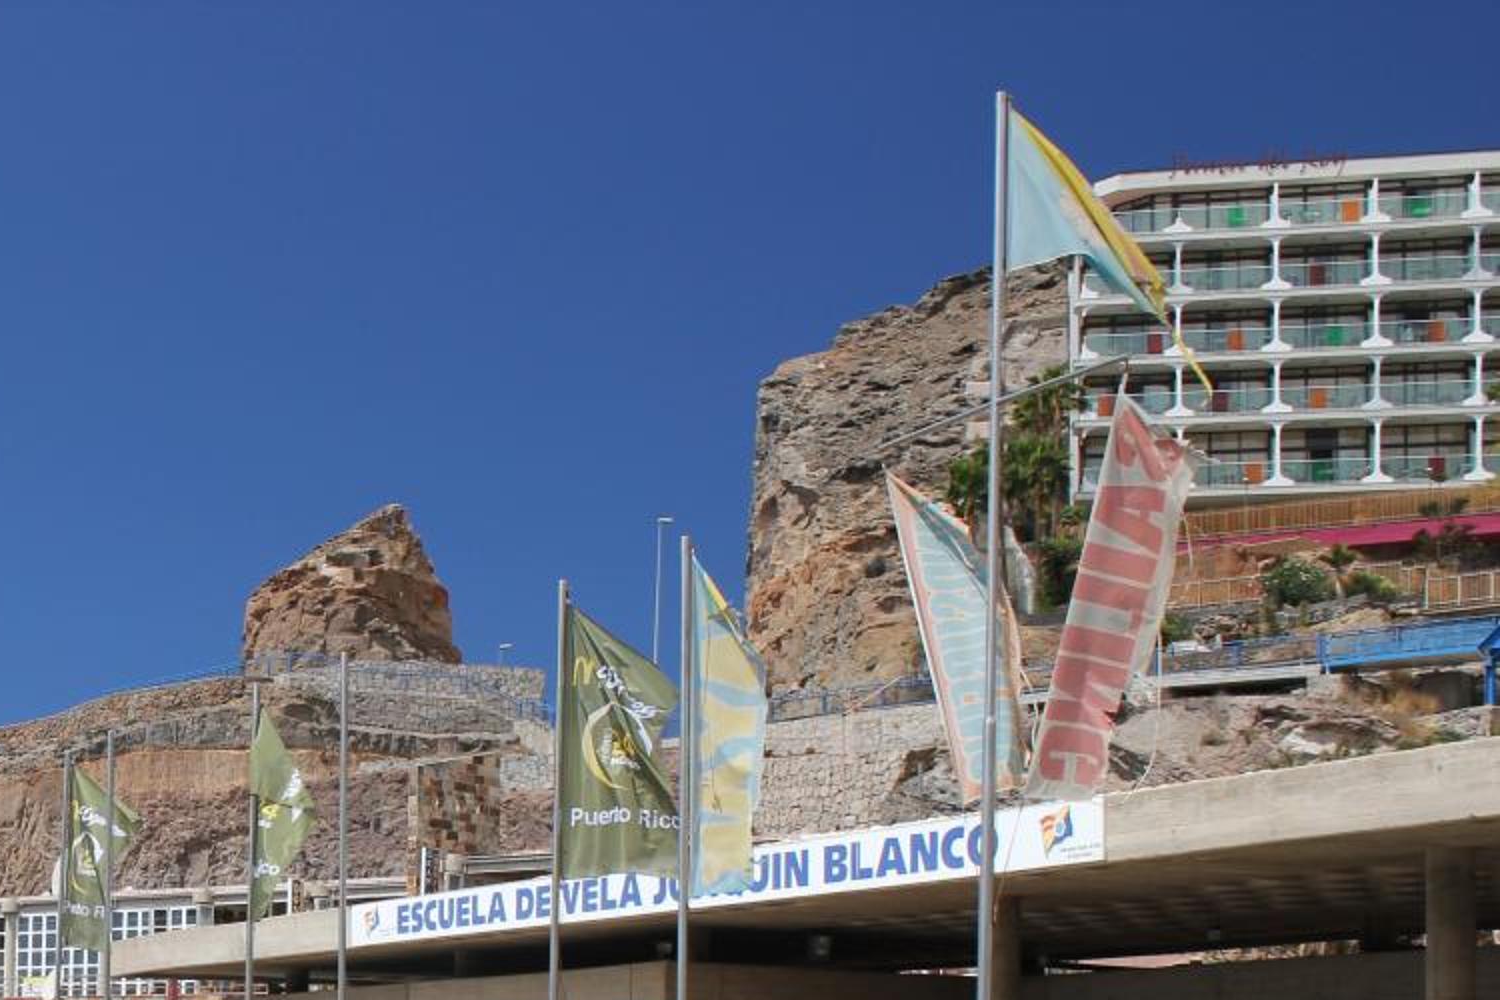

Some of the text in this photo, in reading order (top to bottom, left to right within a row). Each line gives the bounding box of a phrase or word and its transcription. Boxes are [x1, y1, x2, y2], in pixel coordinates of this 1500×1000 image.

[571, 807, 630, 827] Puerto
[397, 823, 999, 935] ESCUELA DE VELA JUIN BLANCO
